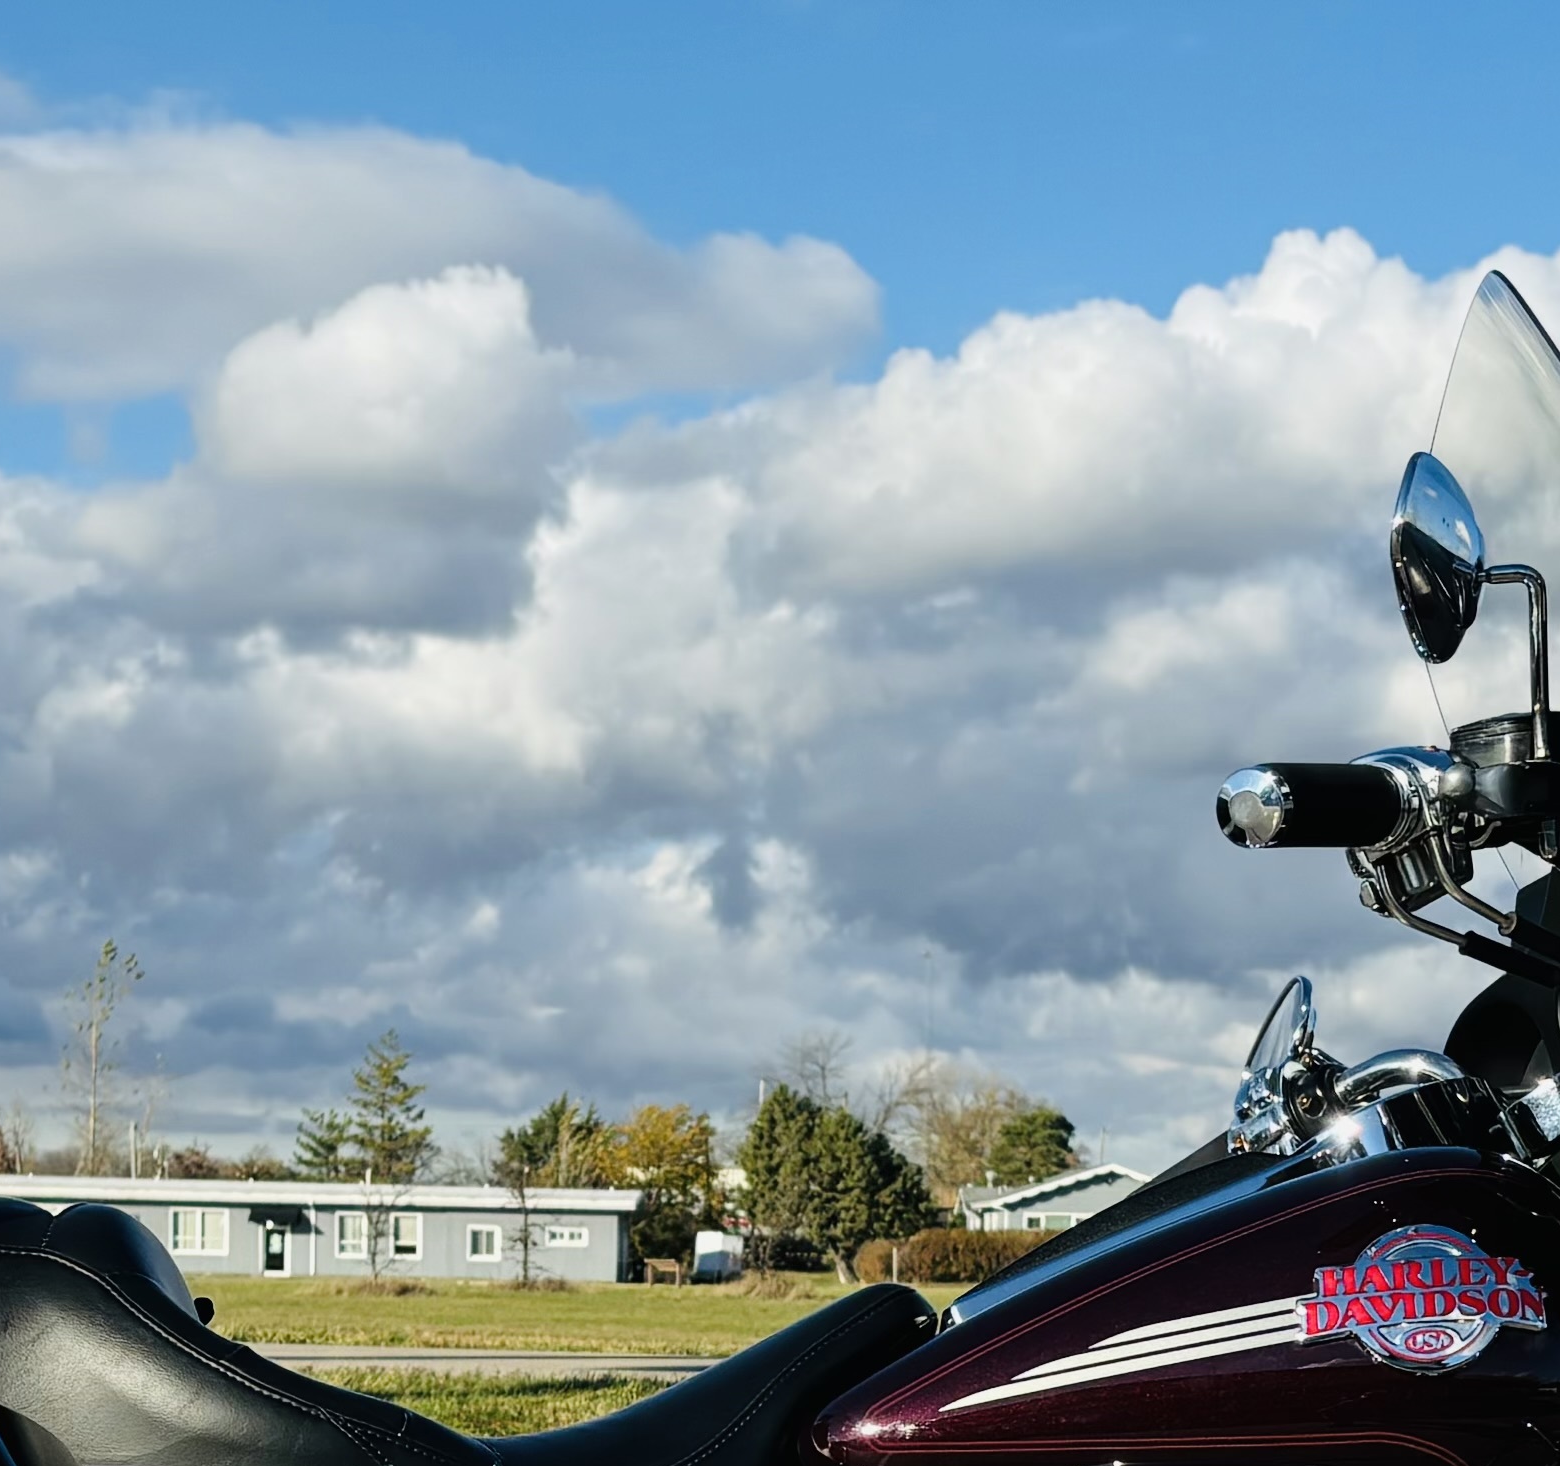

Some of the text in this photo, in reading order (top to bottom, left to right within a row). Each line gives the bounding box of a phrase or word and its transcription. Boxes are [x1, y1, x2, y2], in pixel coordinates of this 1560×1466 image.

[1321, 1257, 1534, 1298] HARLEY-
[1304, 1288, 1545, 1336] DAVIDSON
[1407, 1331, 1452, 1352] USA
